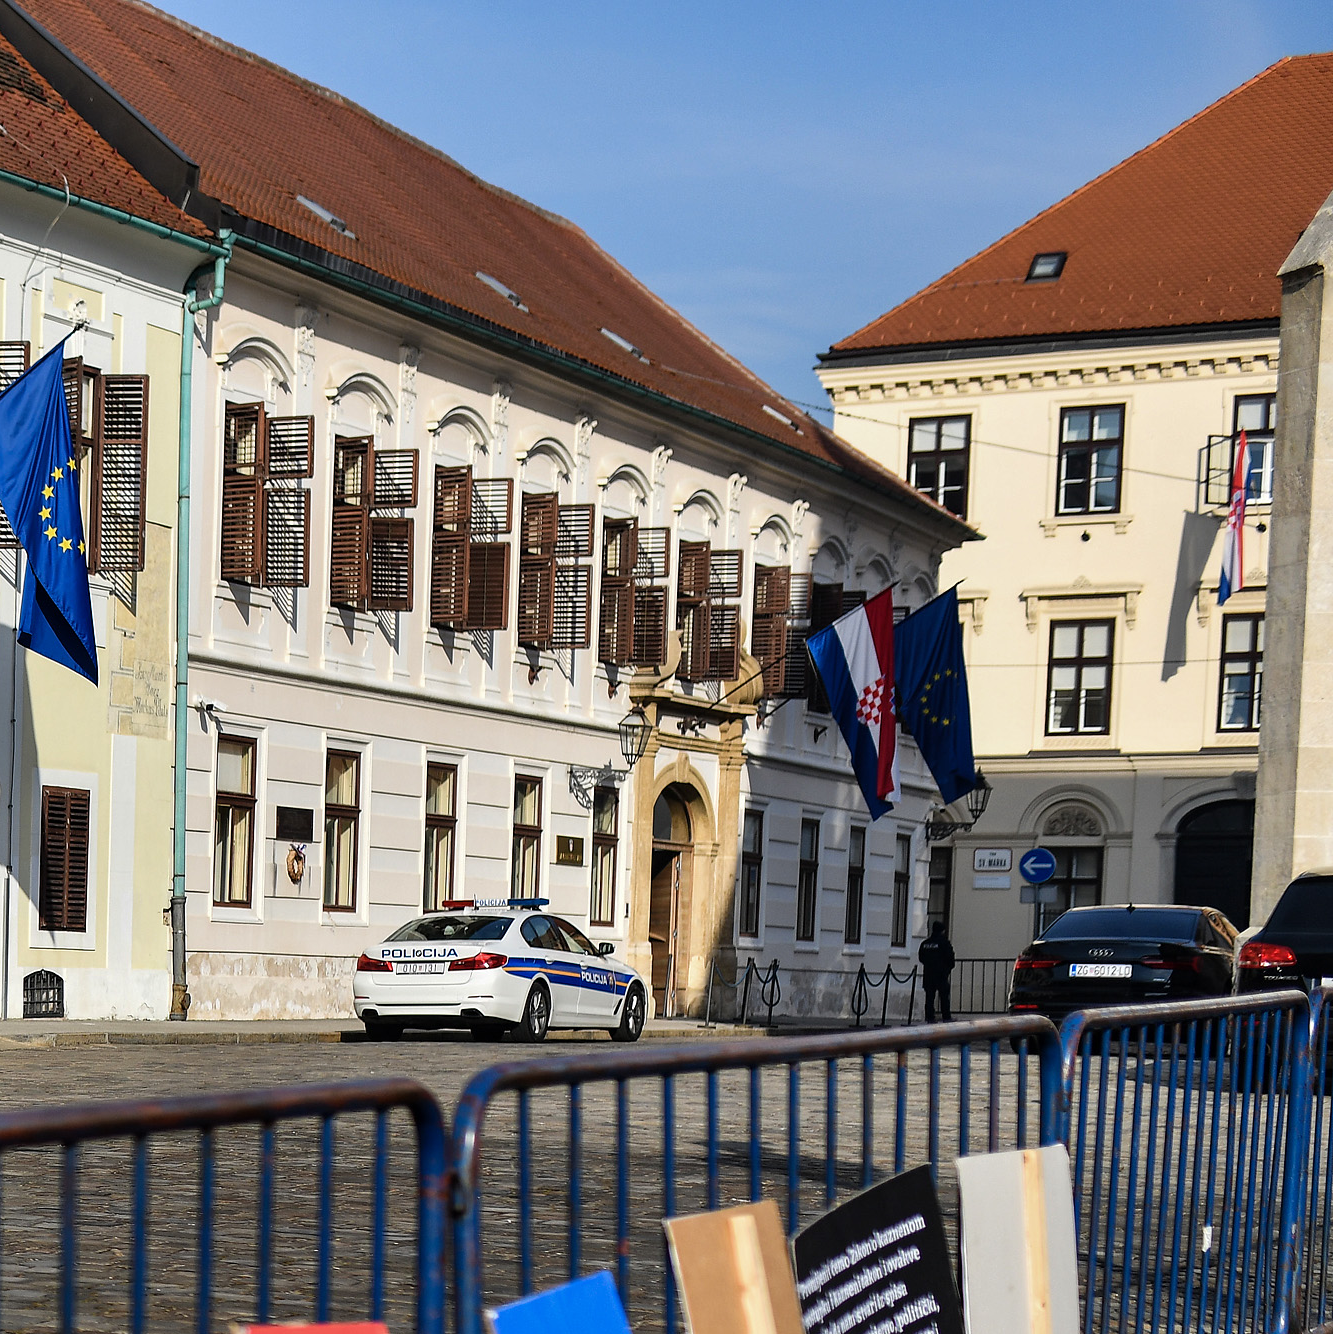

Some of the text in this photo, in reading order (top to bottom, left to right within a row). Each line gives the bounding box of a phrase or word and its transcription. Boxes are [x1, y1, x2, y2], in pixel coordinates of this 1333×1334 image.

[988, 858, 1007, 867] MARKA
[476, 899, 506, 907] POLICIJA
[381, 948, 458, 958] POLICIJA
[1077, 965, 1089, 976] ZG
[581, 971, 608, 986] POLICIJA
[874, 1213, 927, 1249] kaznenom
[888, 1245, 921, 1273] ovakve
[883, 1281, 908, 1309] spisa
[895, 1293, 941, 1332] politički,
